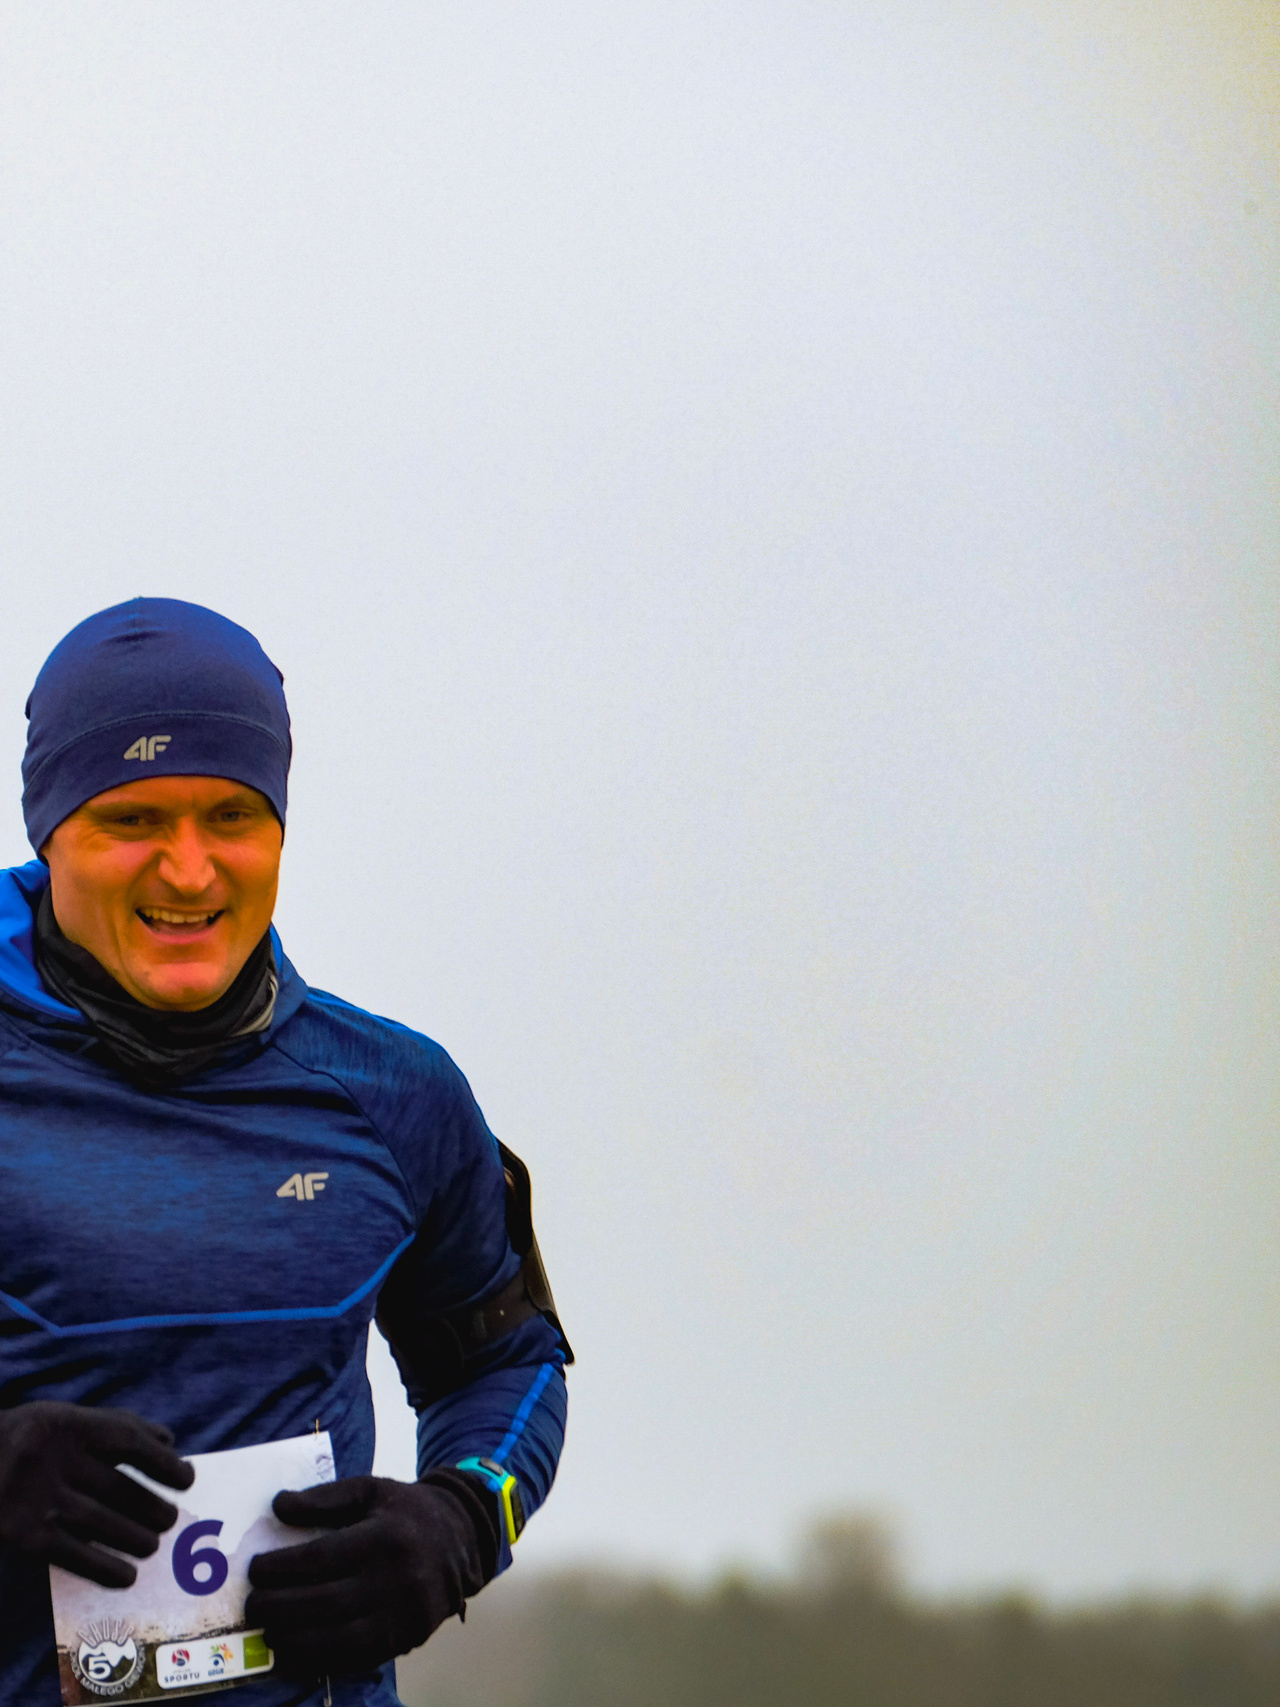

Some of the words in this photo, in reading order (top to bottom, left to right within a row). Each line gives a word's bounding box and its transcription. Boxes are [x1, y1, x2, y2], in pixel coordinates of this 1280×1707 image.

[123, 735, 171, 762] 4F
[276, 1172, 329, 1201] 4F
[172, 1519, 228, 1596] 6
[78, 1616, 135, 1649] CROSS
[88, 1655, 111, 1680] 5
